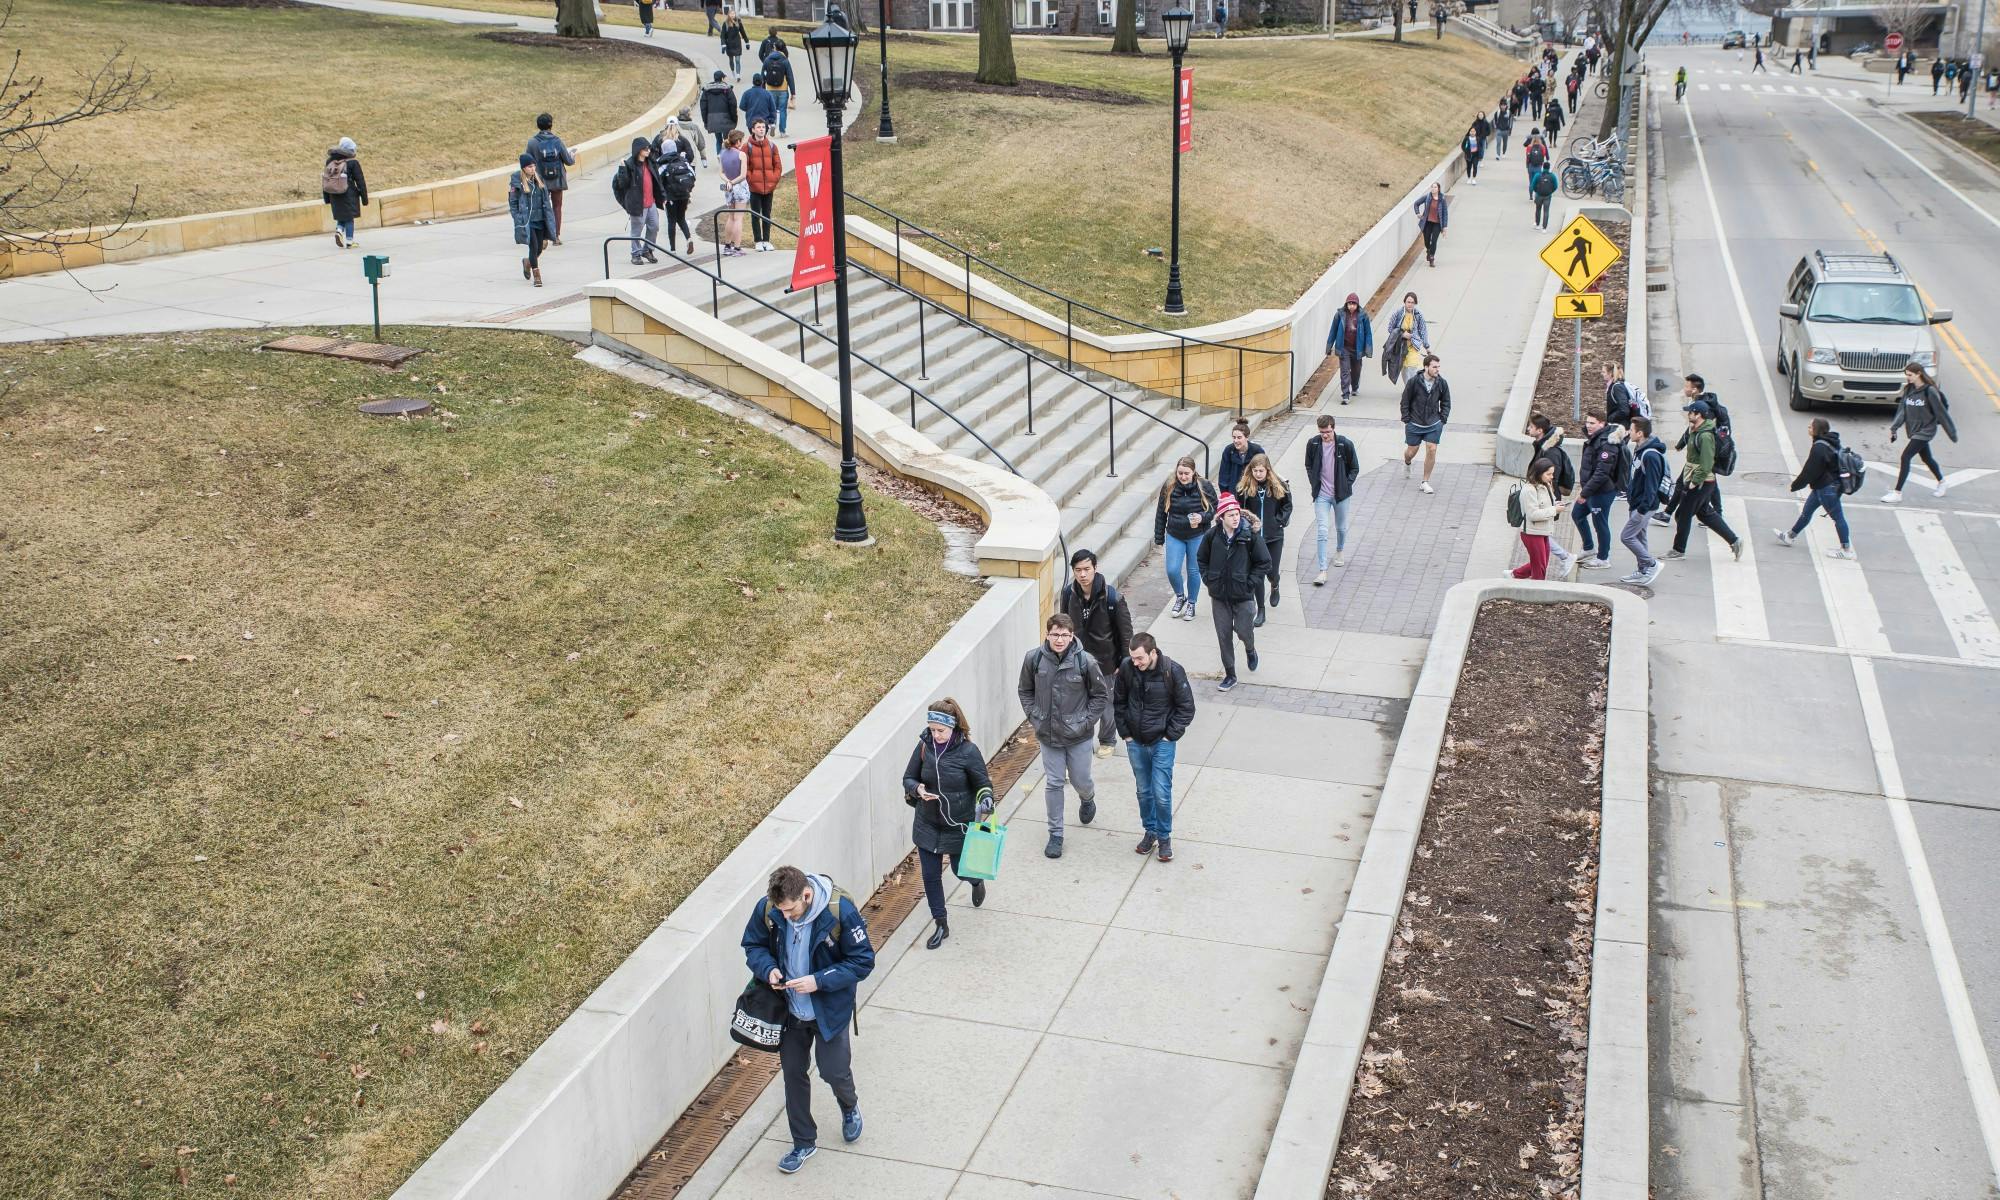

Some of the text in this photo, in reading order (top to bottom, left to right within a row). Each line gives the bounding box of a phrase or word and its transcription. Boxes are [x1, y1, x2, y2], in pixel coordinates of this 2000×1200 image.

[1182, 79, 1189, 98] W
[805, 162, 822, 198] W
[853, 929, 867, 944] 12
[734, 1015, 780, 1039] BEARS
